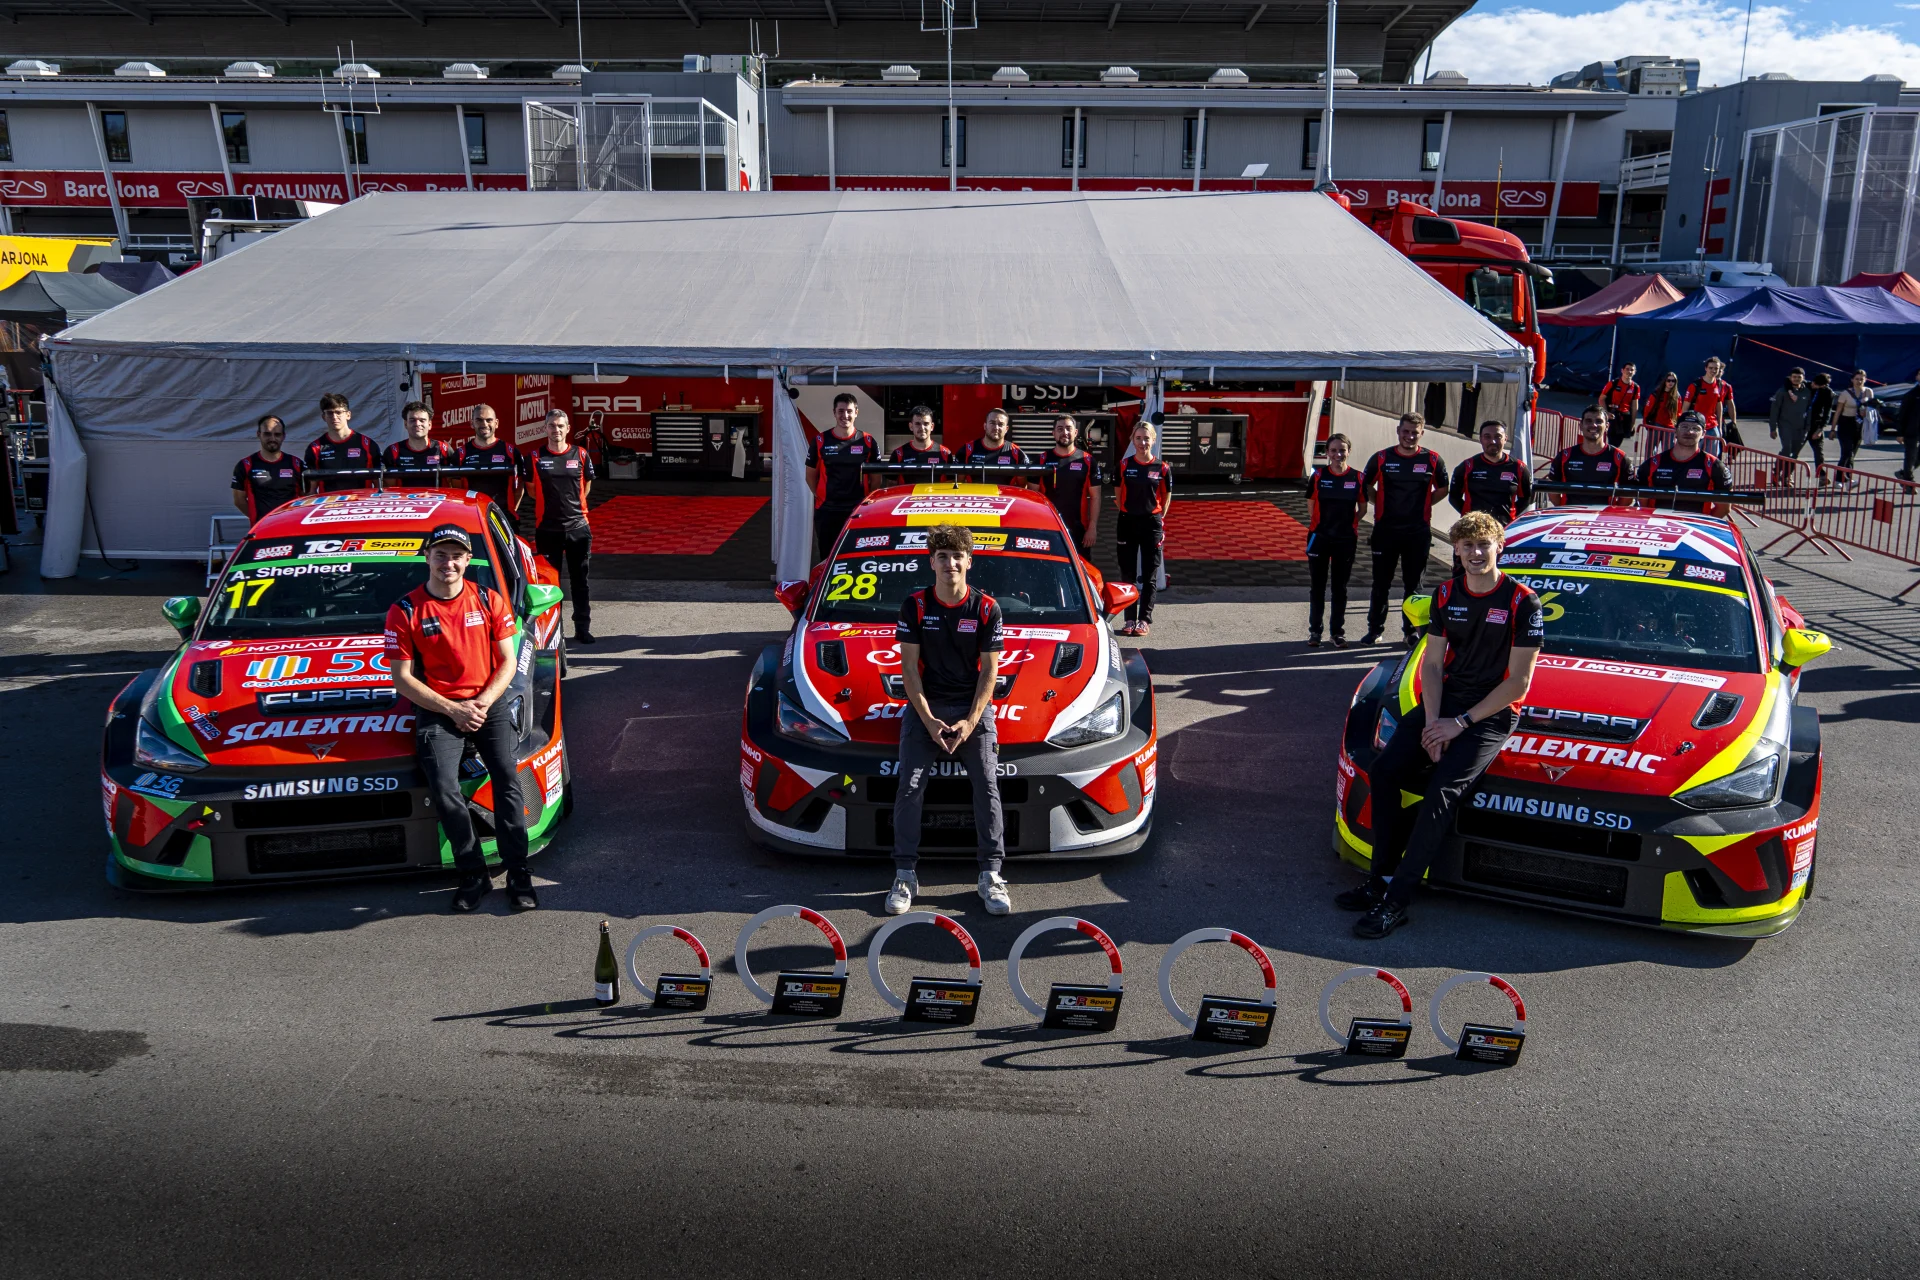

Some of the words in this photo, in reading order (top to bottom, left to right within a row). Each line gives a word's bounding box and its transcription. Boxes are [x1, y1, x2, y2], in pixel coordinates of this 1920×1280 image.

[64, 180, 159, 198] Barclona
[243, 184, 343, 199] CATALUNYA
[1033, 385, 1078, 400] SSD
[520, 399, 546, 422] MOTUL
[572, 396, 641, 412] PRA
[308, 514, 373, 523] TECHNICAL
[323, 506, 417, 516] MOTUL
[1562, 527, 1663, 541] MOTUL
[1587, 520, 1682, 533] MONLAU
[434, 529, 467, 541] KUMHO
[857, 536, 890, 544] AUTO
[900, 532, 928, 544] TC
[1016, 537, 1049, 545] AUTO
[1547, 535, 1614, 543] TECHNICAL
[1617, 539, 1670, 548] SCHOOL
[256, 545, 294, 555] AUTO
[303, 539, 367, 554] TCR
[369, 540, 416, 549] Spain
[855, 541, 889, 549] SPORT
[1016, 542, 1049, 550] SPORT
[254, 551, 293, 560] SPORT
[1499, 553, 1536, 561] AUTO
[1549, 551, 1614, 566] TCR
[1617, 557, 1667, 569] Spain
[230, 571, 251, 581] A.
[255, 563, 353, 577] Shepherd
[832, 562, 853, 575] E.
[860, 559, 919, 573] Gené
[1590, 567, 1644, 575] CHAMPIONSHIP
[1685, 564, 1726, 576] AUTO
[1684, 571, 1726, 583] SPORT
[226, 578, 275, 609] 17
[826, 573, 878, 600] 28
[248, 641, 332, 652] MONLAU
[1585, 663, 1659, 678] MOTUL
[242, 674, 393, 689] COMMUNICATI
[265, 688, 397, 705] CUPRA
[183, 705, 221, 738] Palmers
[223, 715, 416, 745] SCALEXTRIC
[532, 739, 563, 770] KUMHO
[1501, 736, 1664, 774] ALEXTRIC
[996, 764, 1018, 777] SD
[153, 775, 184, 792] 5G
[244, 776, 359, 800] SAMSUNG
[363, 777, 399, 791] SSD
[1473, 791, 1590, 823] SAMSUNG
[1593, 811, 1632, 830] SSD
